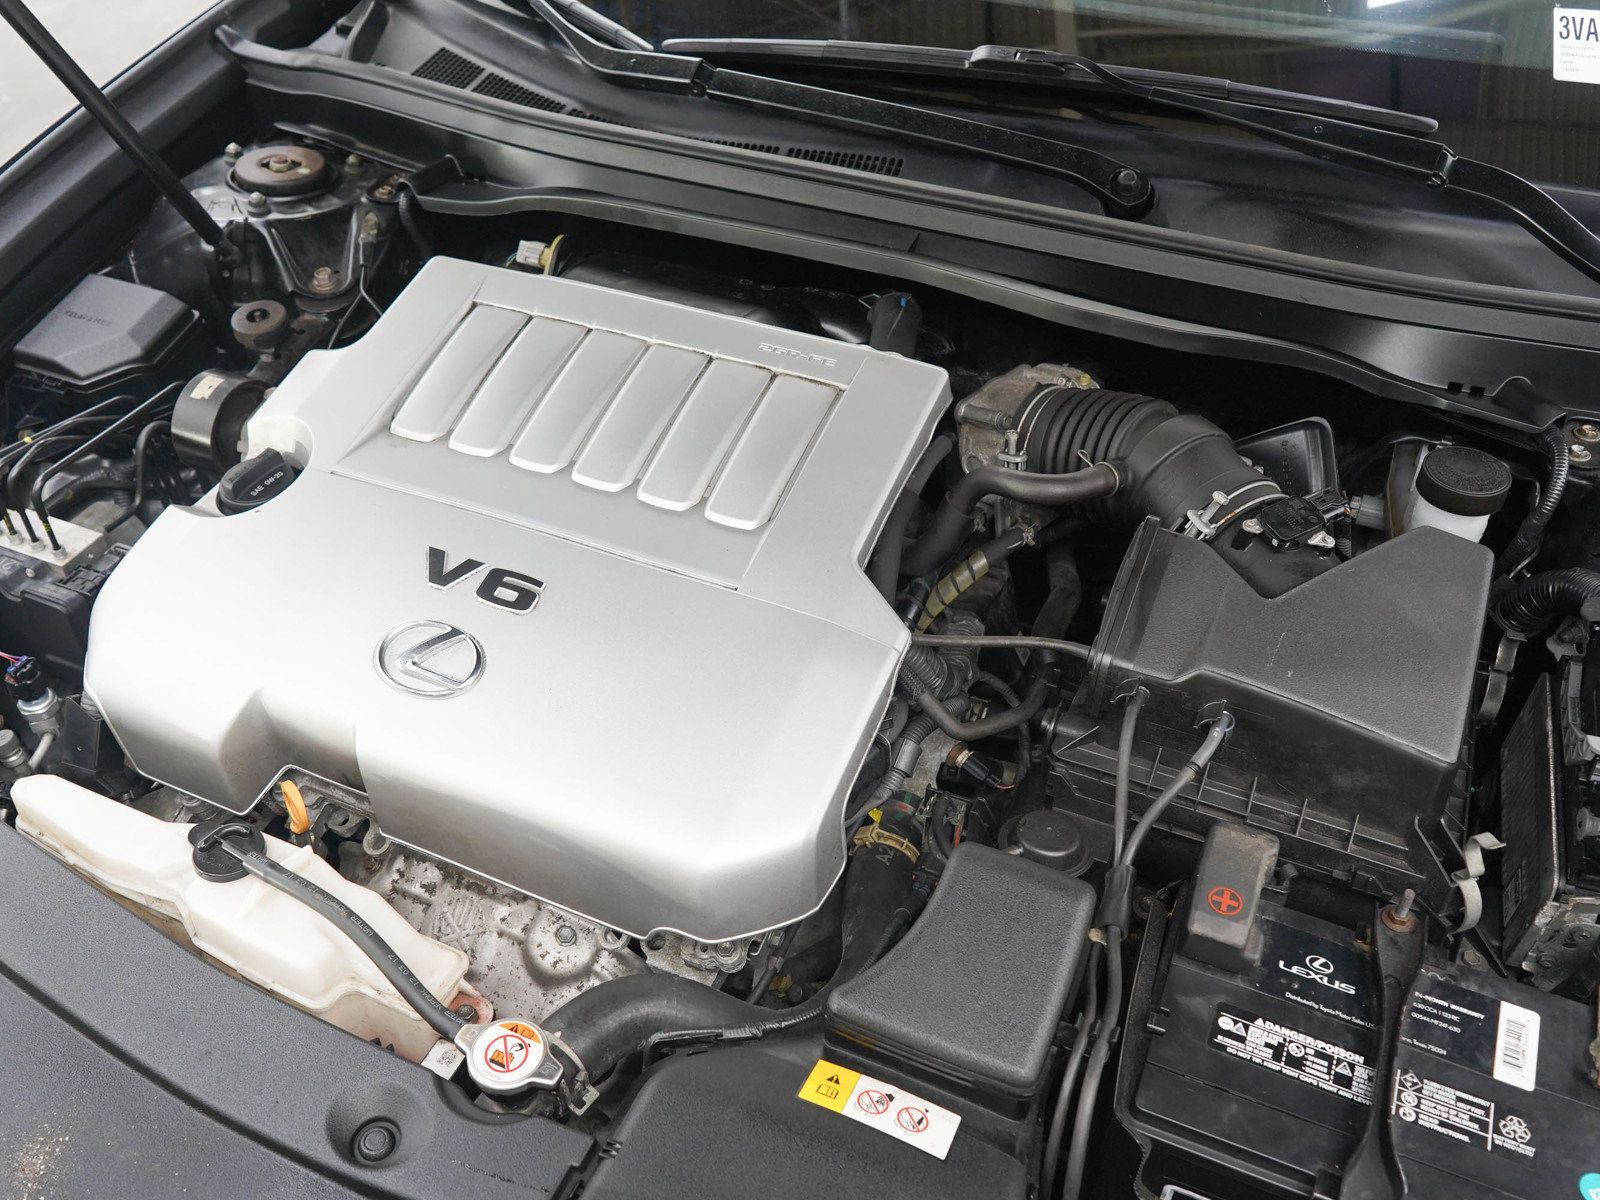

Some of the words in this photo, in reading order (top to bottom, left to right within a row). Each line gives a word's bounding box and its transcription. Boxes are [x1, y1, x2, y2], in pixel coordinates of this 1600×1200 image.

[250, 485, 264, 496] SAE
[425, 545, 546, 614] V6
[1279, 960, 1356, 994] LEXUS
[1424, 1005, 1437, 1014] CCA
[1449, 1003, 1484, 1019] WARRANTY
[1264, 1021, 1364, 1064] DANGER/POISON
[1237, 1051, 1251, 1059] NOT
[1263, 1061, 1281, 1070] KEEP
